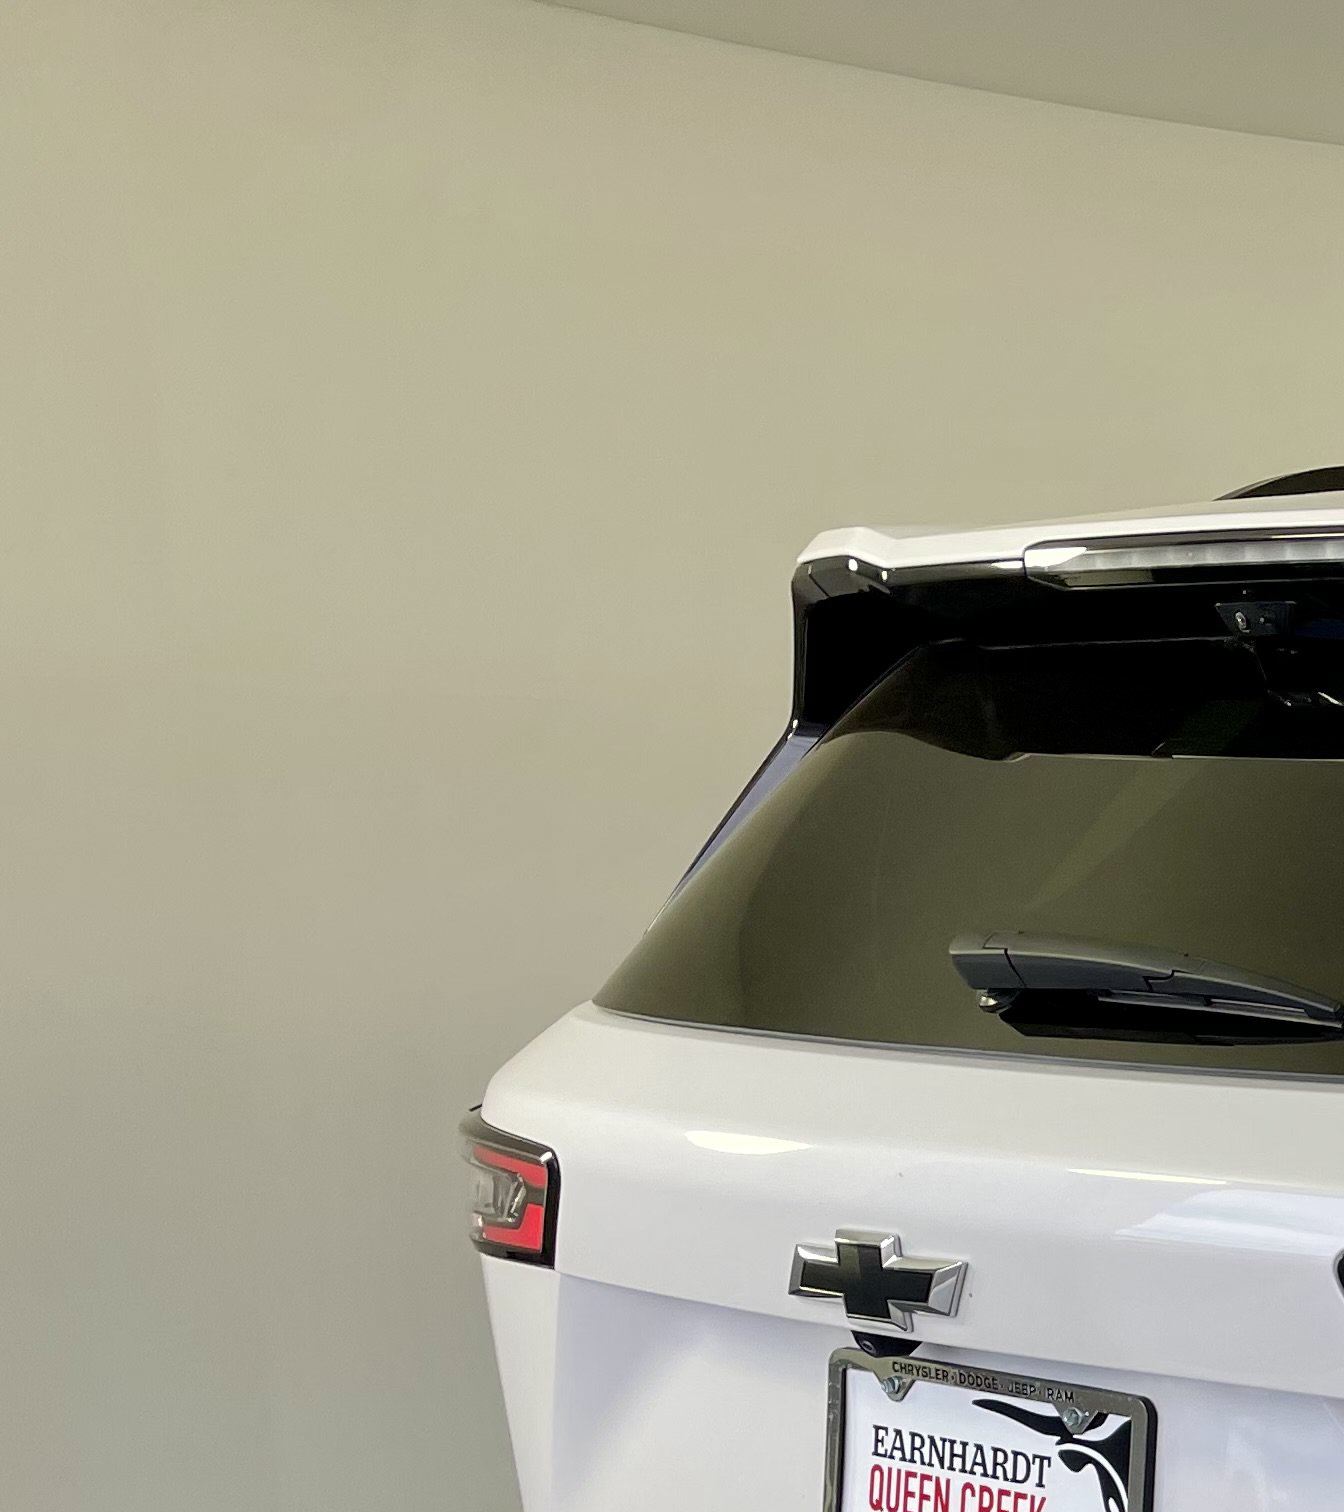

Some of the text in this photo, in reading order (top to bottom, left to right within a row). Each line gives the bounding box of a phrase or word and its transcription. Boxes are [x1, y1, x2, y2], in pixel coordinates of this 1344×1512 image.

[892, 1361, 949, 1382] CHRYSLER
[959, 1371, 999, 1391] DODGE
[1046, 1388, 1075, 1404] RAM
[871, 1424, 1052, 1488] EARNHARDT
